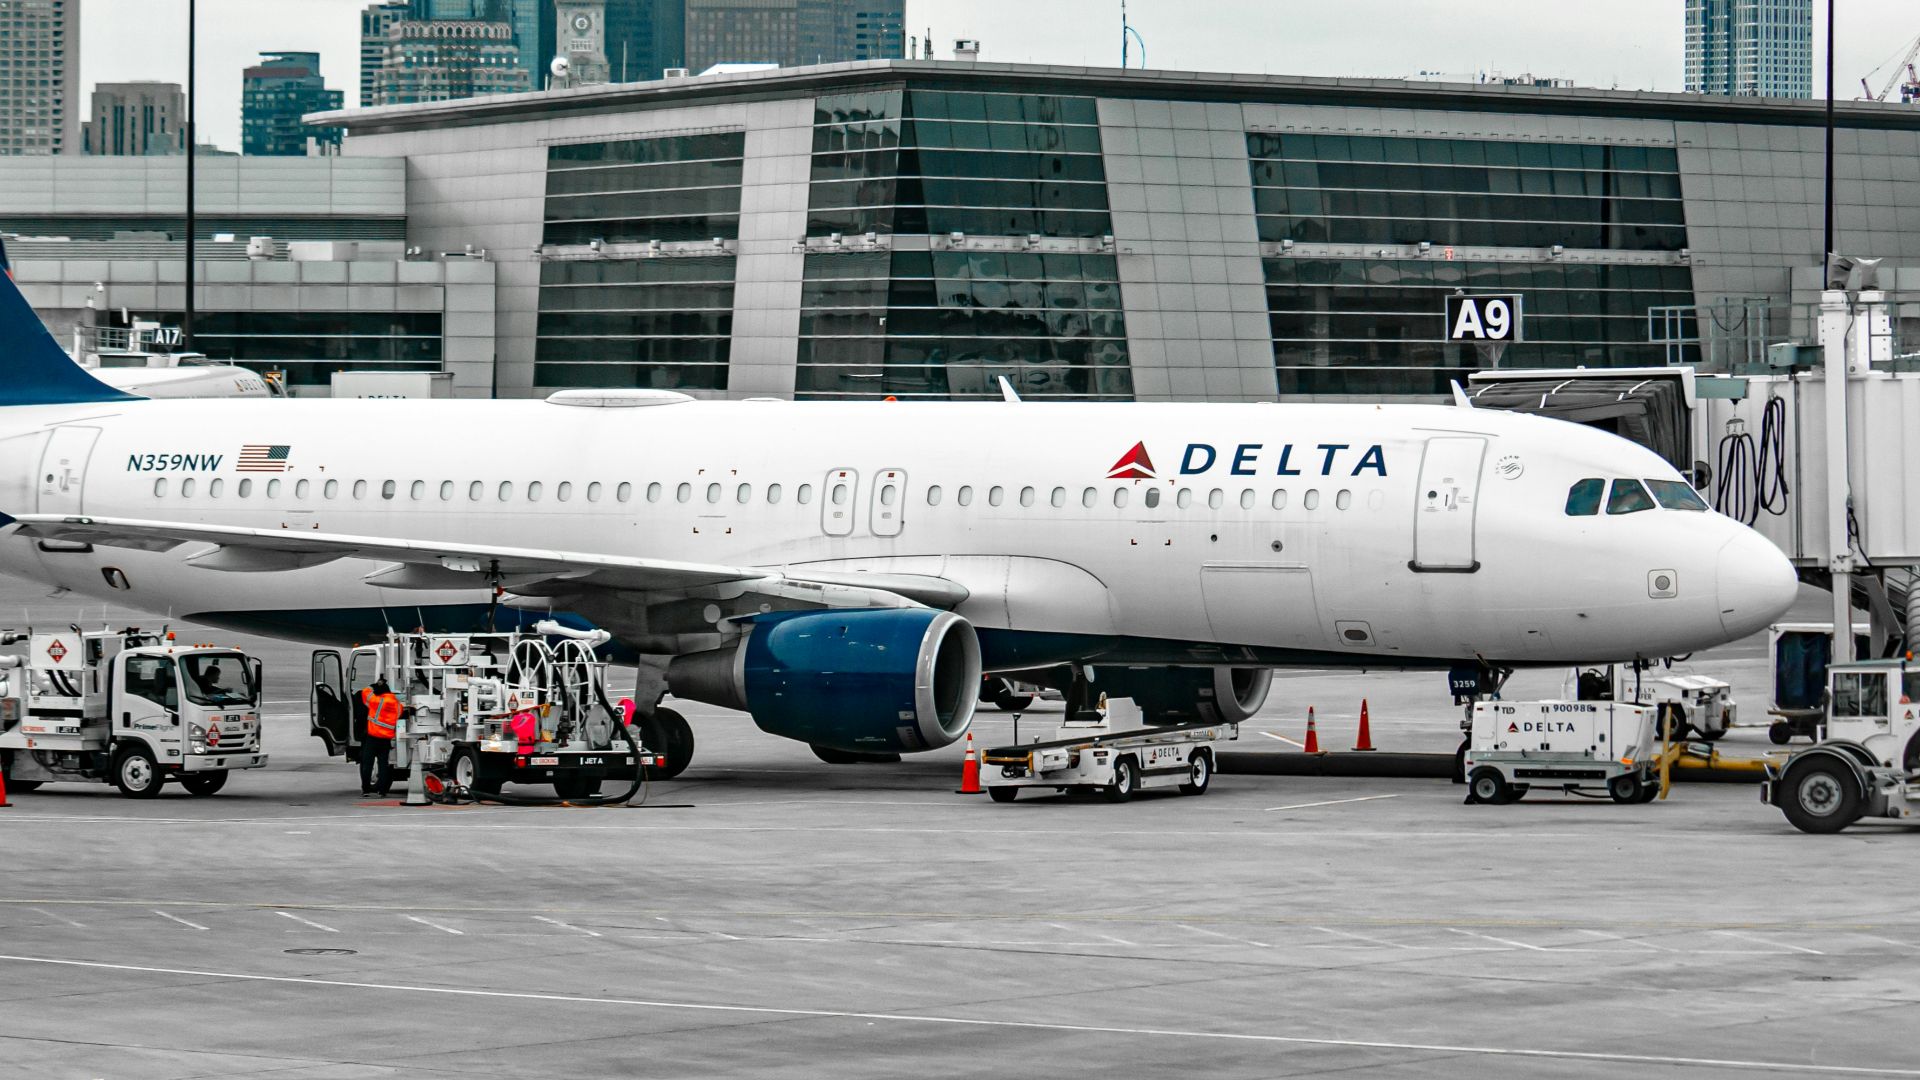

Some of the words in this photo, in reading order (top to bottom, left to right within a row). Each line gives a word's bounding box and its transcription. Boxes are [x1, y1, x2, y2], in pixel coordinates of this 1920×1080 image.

[1452, 299, 1510, 339] A9
[155, 329, 180, 344] A17
[127, 454, 223, 472] N359NW
[1179, 443, 1388, 477] DELTA
[1453, 680, 1476, 688] 3259
[1502, 706, 1516, 714] TLD
[1524, 722, 1575, 732] DELTA
[1158, 747, 1180, 757] DELTA
